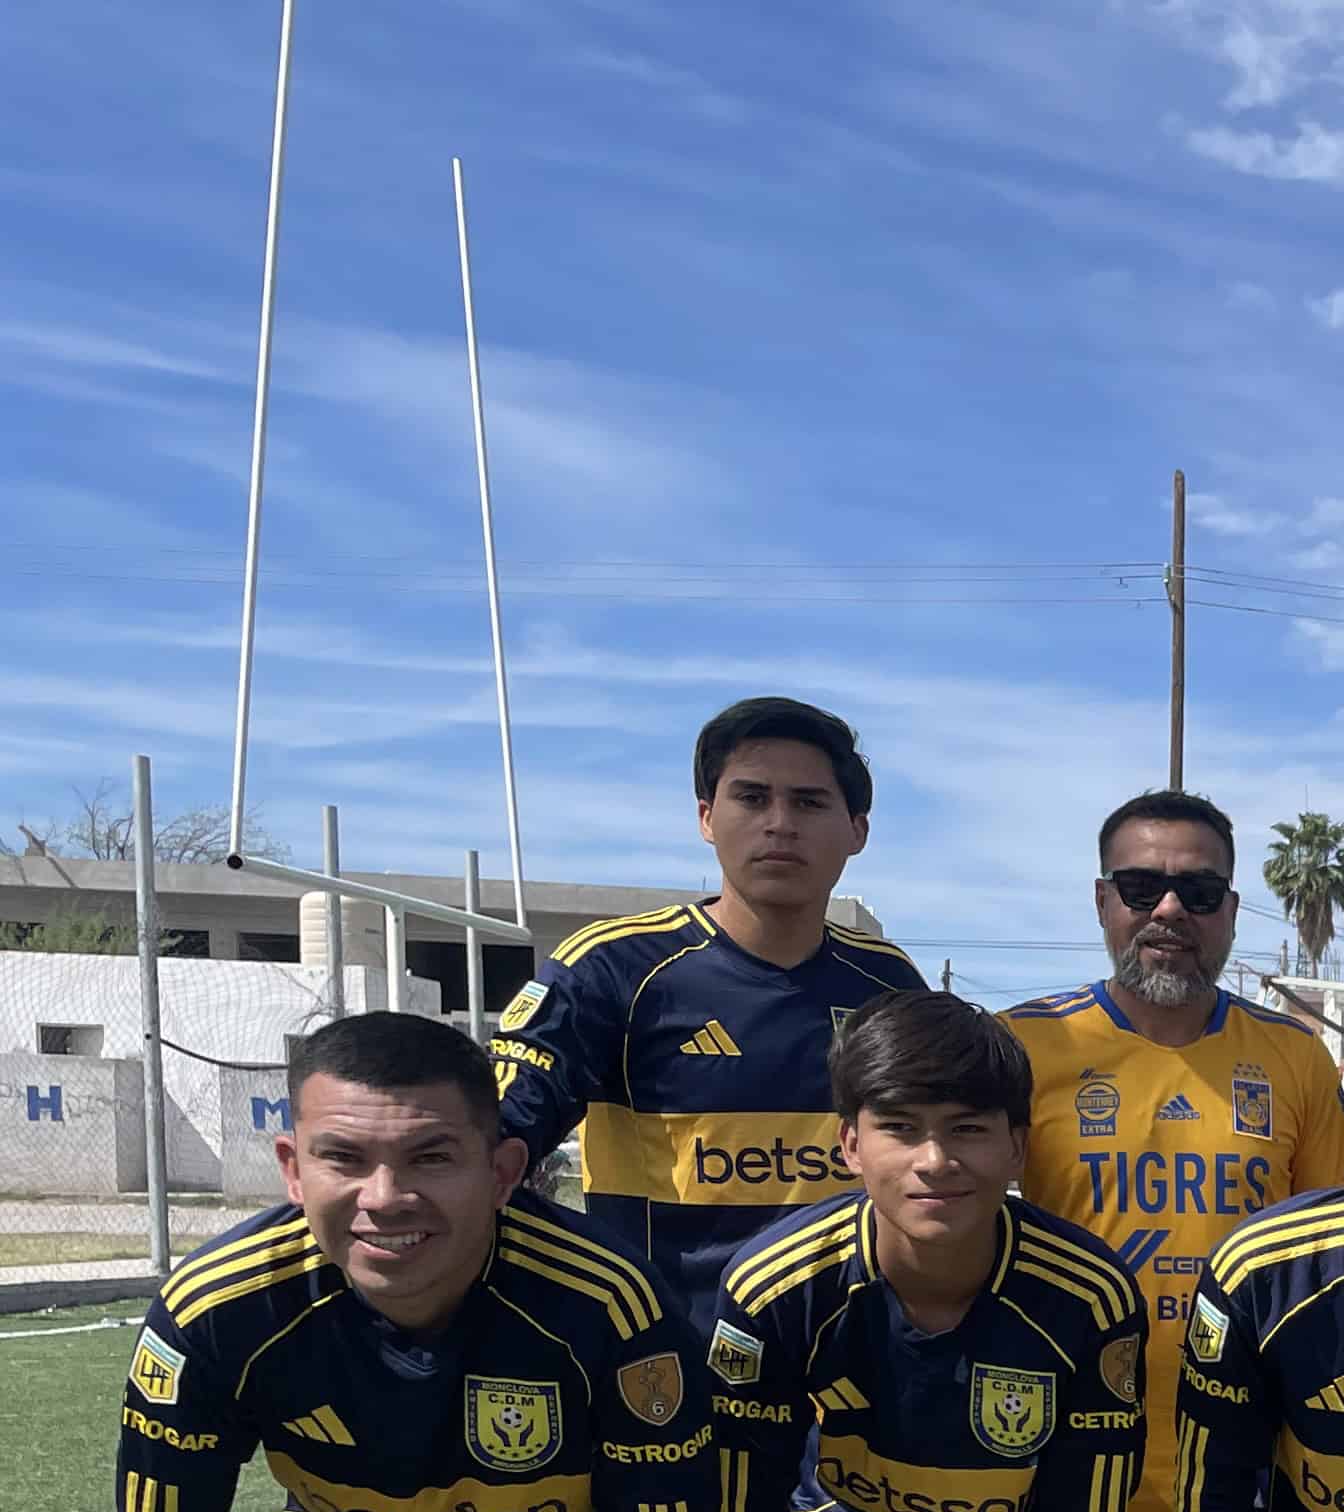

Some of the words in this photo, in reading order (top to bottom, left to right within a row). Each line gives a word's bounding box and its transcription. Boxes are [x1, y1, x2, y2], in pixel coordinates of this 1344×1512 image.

[27, 1085, 63, 1121] H
[251, 1096, 292, 1130] M
[1079, 1151, 1270, 1214] TIGRES
[1158, 1294, 1190, 1321] Bi
[488, 1393, 536, 1407] C.D.M
[992, 1381, 1034, 1394] C.D.M
[651, 1400, 666, 1416] 6
[602, 1423, 714, 1465] CETROGAR
